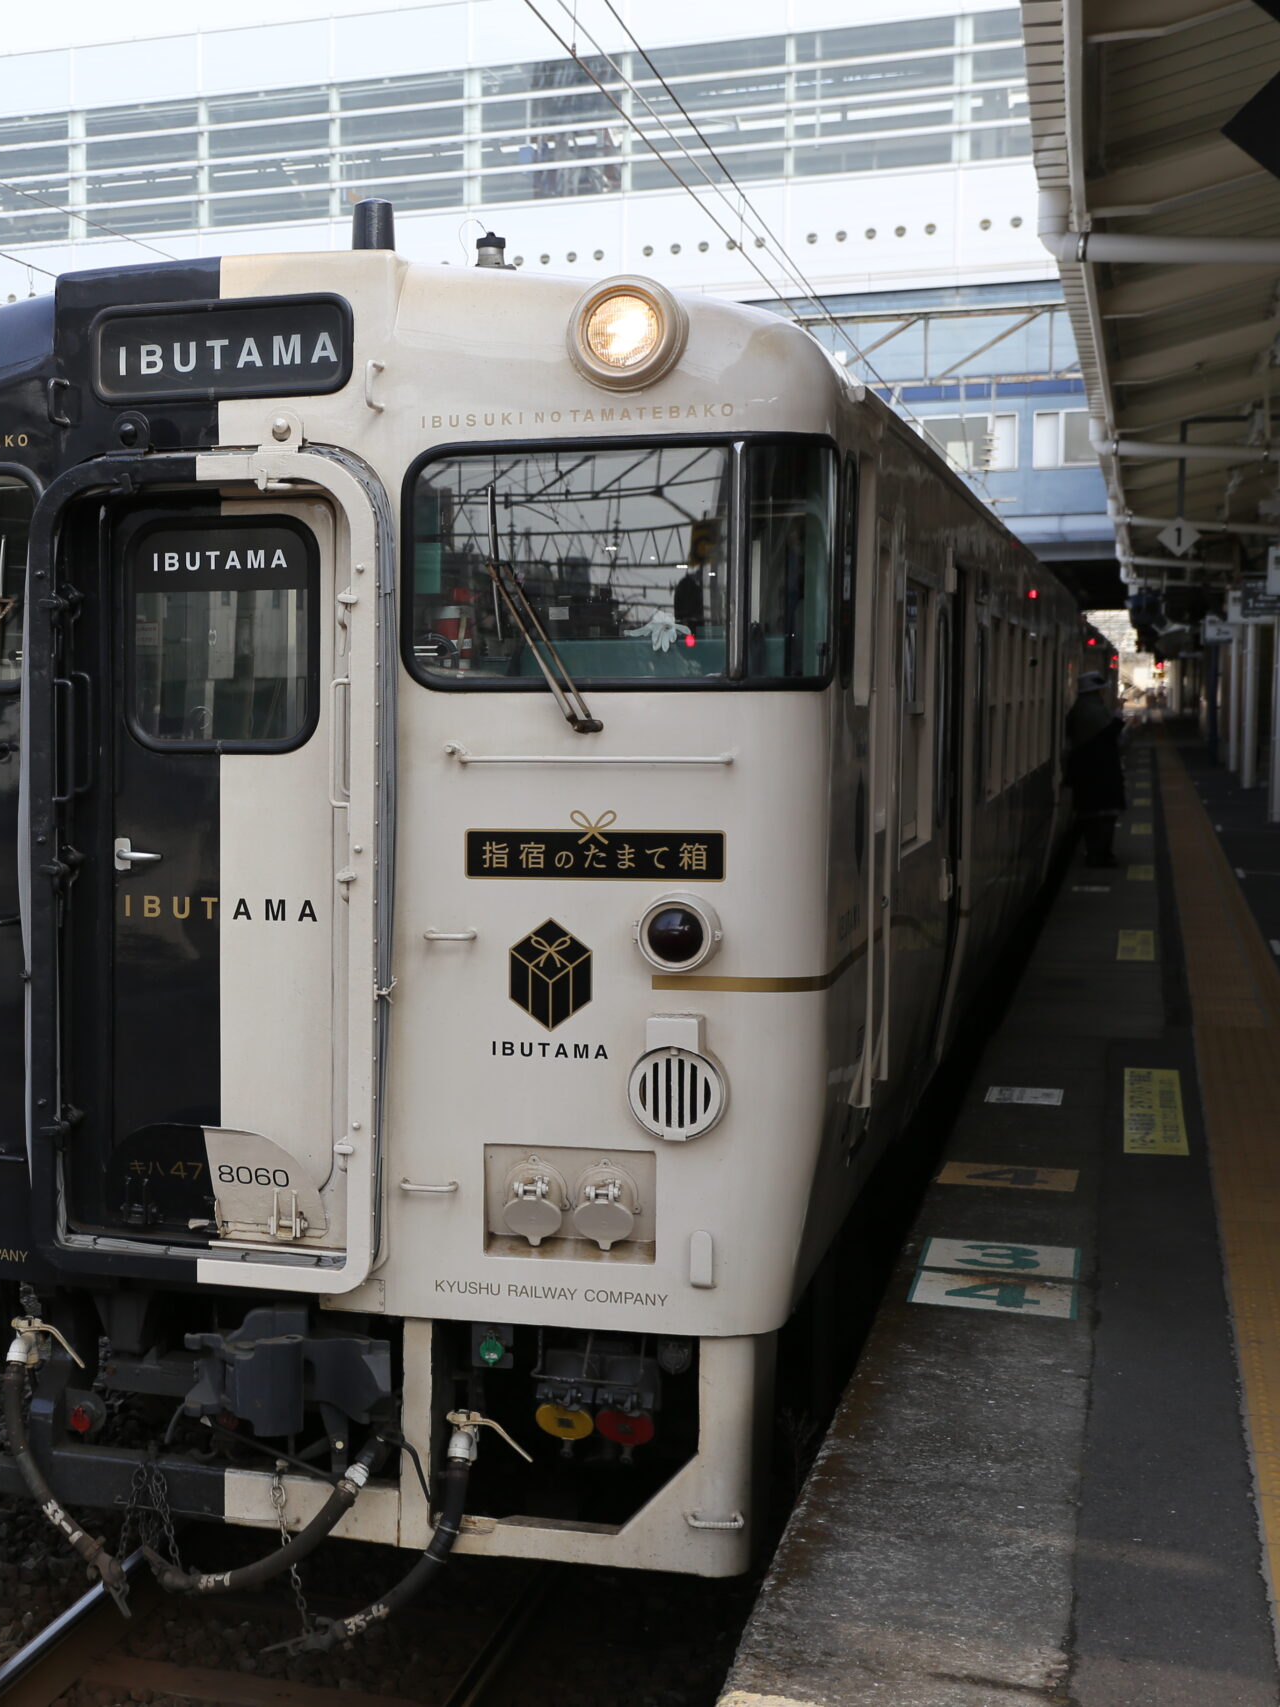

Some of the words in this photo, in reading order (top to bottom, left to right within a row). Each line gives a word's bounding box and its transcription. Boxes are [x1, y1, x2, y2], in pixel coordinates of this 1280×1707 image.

[119, 331, 339, 376] IBUTAMA
[421, 411, 524, 429] IBUSUKI
[534, 411, 562, 424] NO
[569, 403, 735, 422] TAMATEBAKO
[1174, 527, 1182, 547] 1
[153, 548, 288, 573] IBUTAMA
[482, 841, 709, 872] 指宿のたまて箱
[125, 895, 318, 922] IBUTAMA
[491, 1040, 609, 1060] IBUTAMA
[218, 1165, 290, 1188] 8060
[955, 1245, 1040, 1269] 3
[435, 1279, 501, 1296] KYUSHU
[507, 1284, 578, 1301] RAILWAY
[584, 1289, 669, 1307] COMPANY
[945, 1280, 1041, 1308] 4
